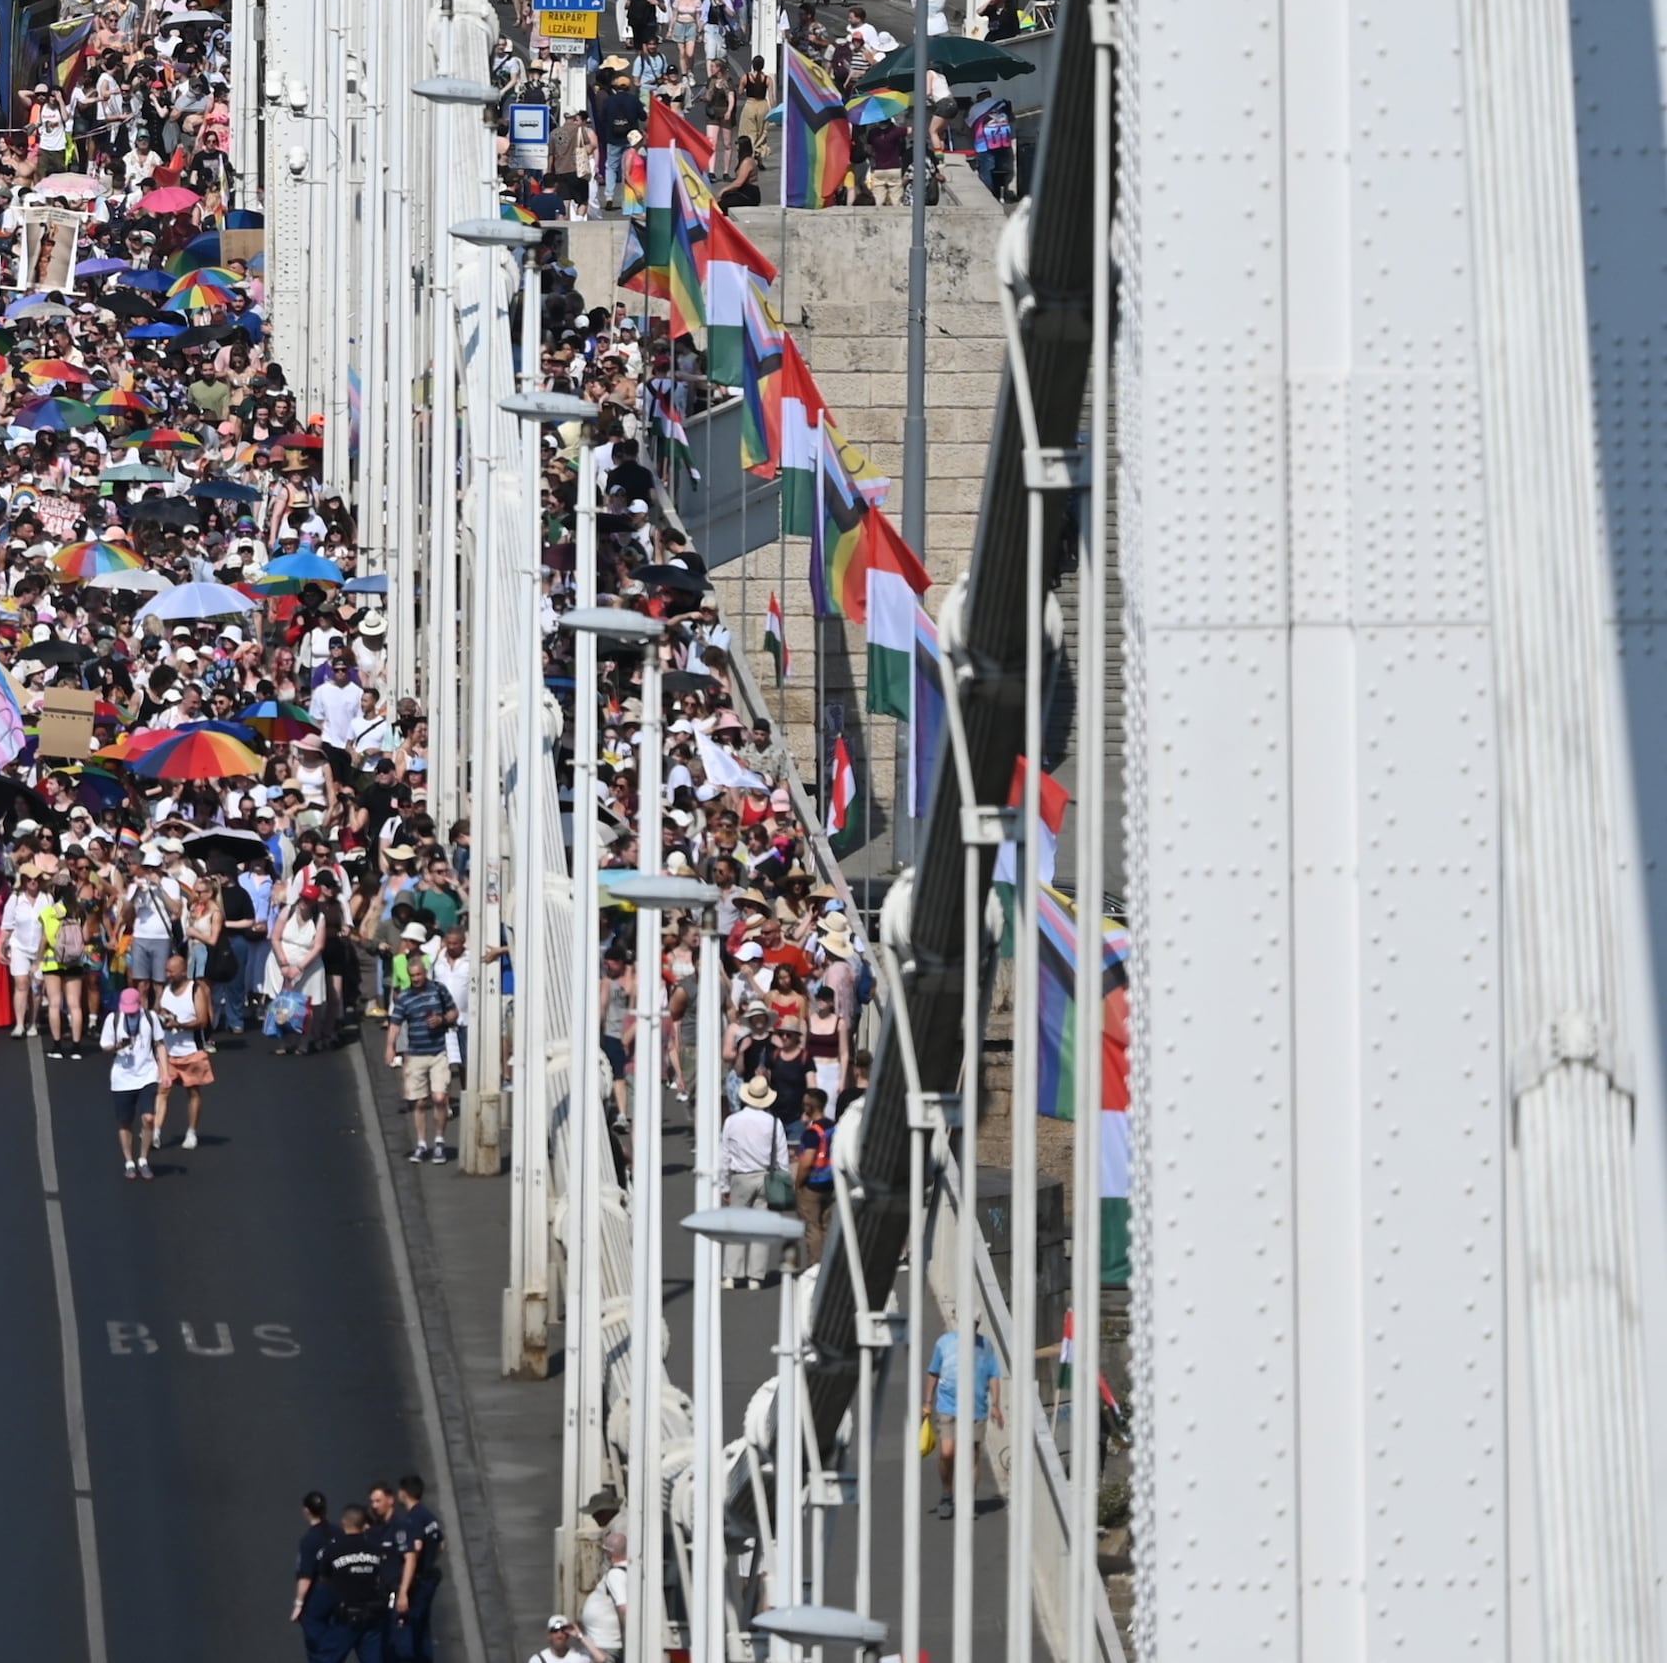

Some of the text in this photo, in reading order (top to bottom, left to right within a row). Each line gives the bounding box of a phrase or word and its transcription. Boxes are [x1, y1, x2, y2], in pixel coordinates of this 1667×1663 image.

[548, 11, 588, 23] RAKPART
[548, 23, 586, 35] LEZÁRVA!
[107, 1320, 301, 1359] BUS
